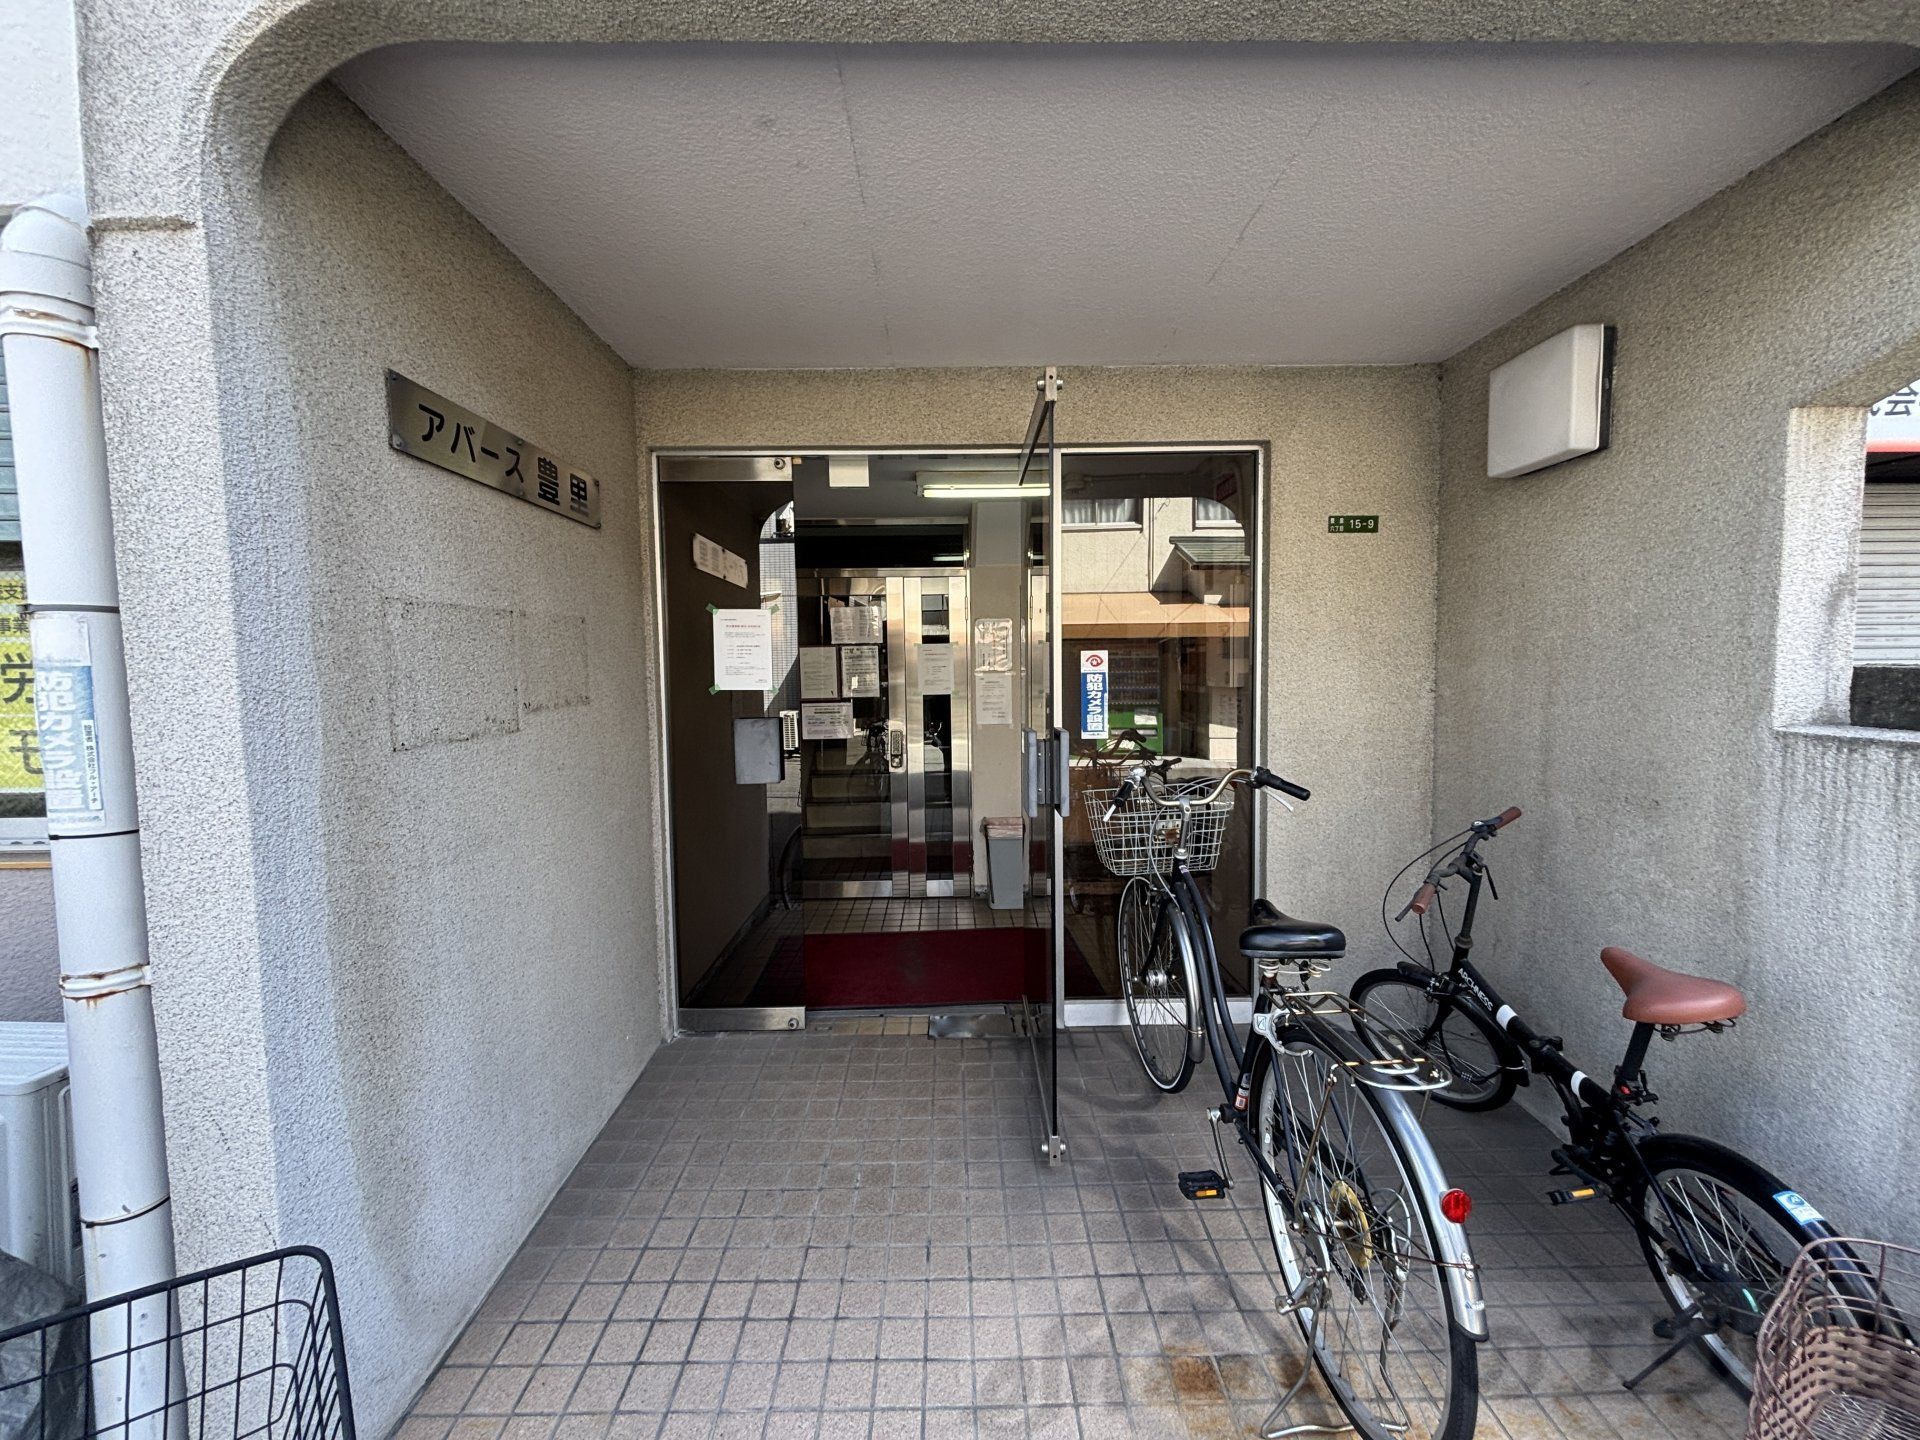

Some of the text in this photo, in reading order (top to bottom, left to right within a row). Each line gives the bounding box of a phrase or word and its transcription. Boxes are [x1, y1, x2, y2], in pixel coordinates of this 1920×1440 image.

[1870, 381, 1919, 417] 会
[1350, 519, 1374, 529] 15-9
[1086, 673, 1104, 731] 防犯カメラ設置
[1458, 967, 1494, 1011] ARCHNESS
